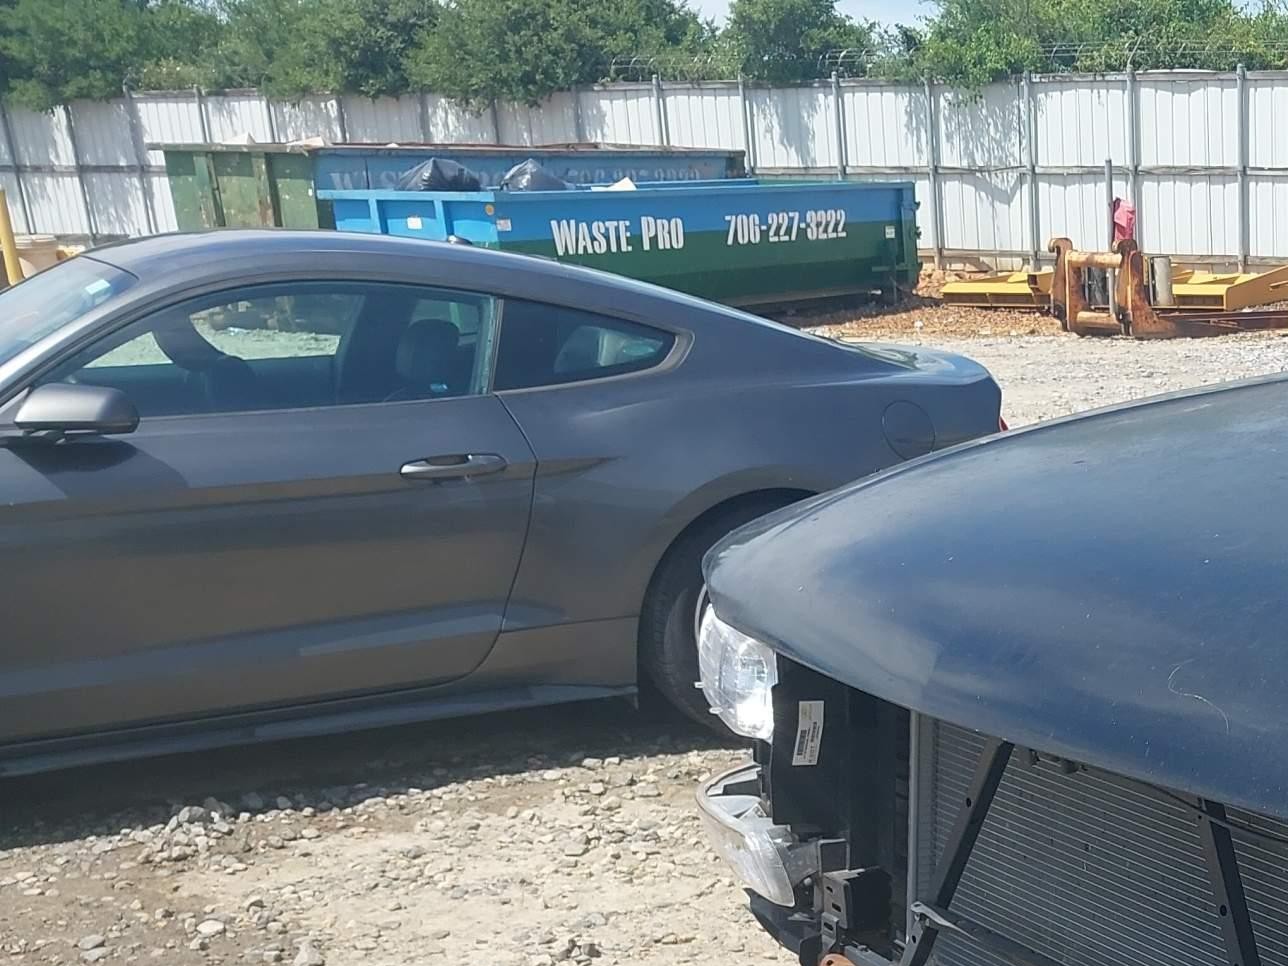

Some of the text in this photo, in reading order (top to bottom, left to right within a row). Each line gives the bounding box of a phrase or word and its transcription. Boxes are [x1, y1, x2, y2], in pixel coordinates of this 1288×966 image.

[550, 209, 848, 257] WASTE PRO 706-227-3222
